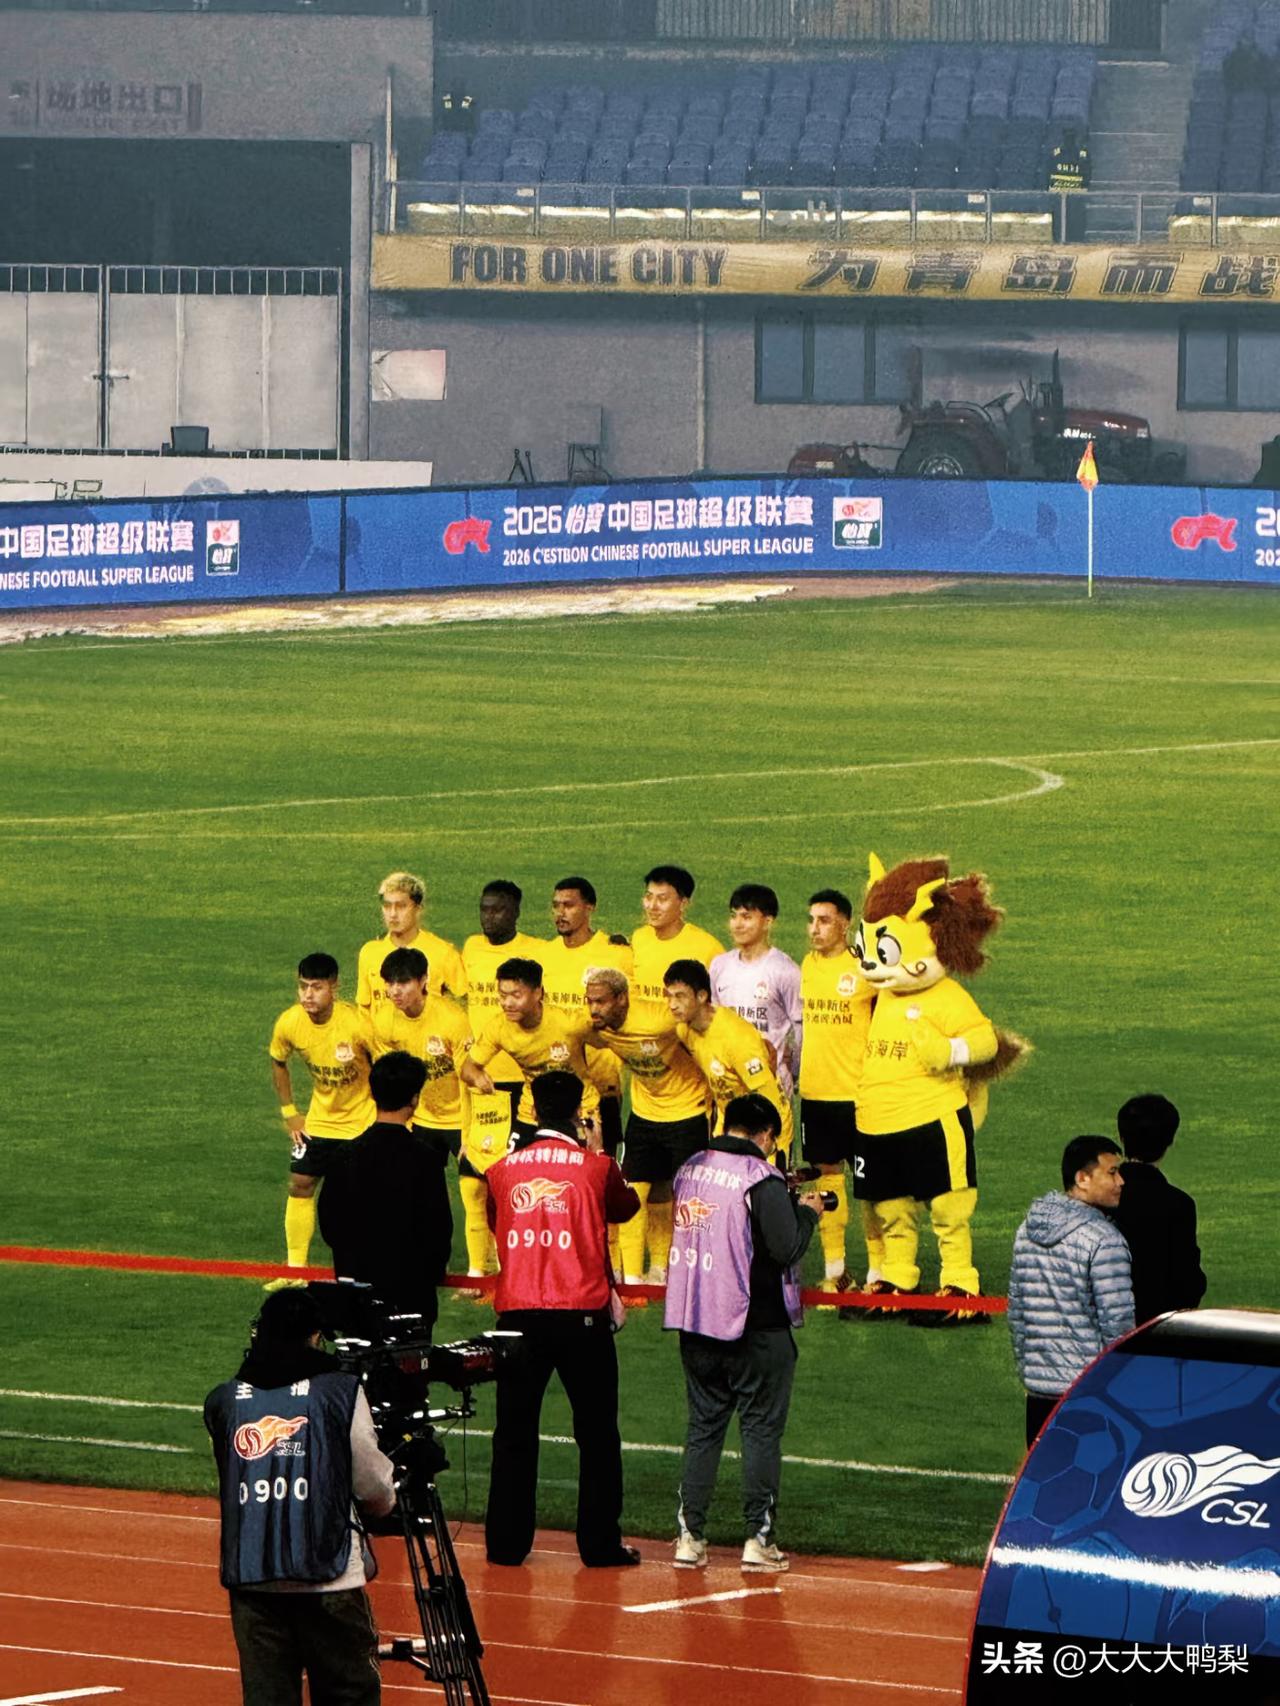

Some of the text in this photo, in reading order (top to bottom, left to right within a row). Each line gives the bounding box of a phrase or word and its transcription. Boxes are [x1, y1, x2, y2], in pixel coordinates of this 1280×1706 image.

[452, 245, 727, 288] FOR ONE CITY
[503, 505, 562, 536] 2026
[608, 495, 813, 532] 中国足球超级联赛
[0, 520, 194, 559] 中国足球超级联赛
[503, 536, 813, 566] 2026 C'ESTBON CHINESE FOOTBALL SUPER LEAGUE
[33, 568, 98, 589] FOOTBALL
[102, 566, 142, 586] SUPER
[146, 563, 194, 584] LEAGUE
[507, 1228, 572, 1249] 0900
[240, 1476, 308, 1505] 0900
[1201, 1498, 1271, 1529] CSL
